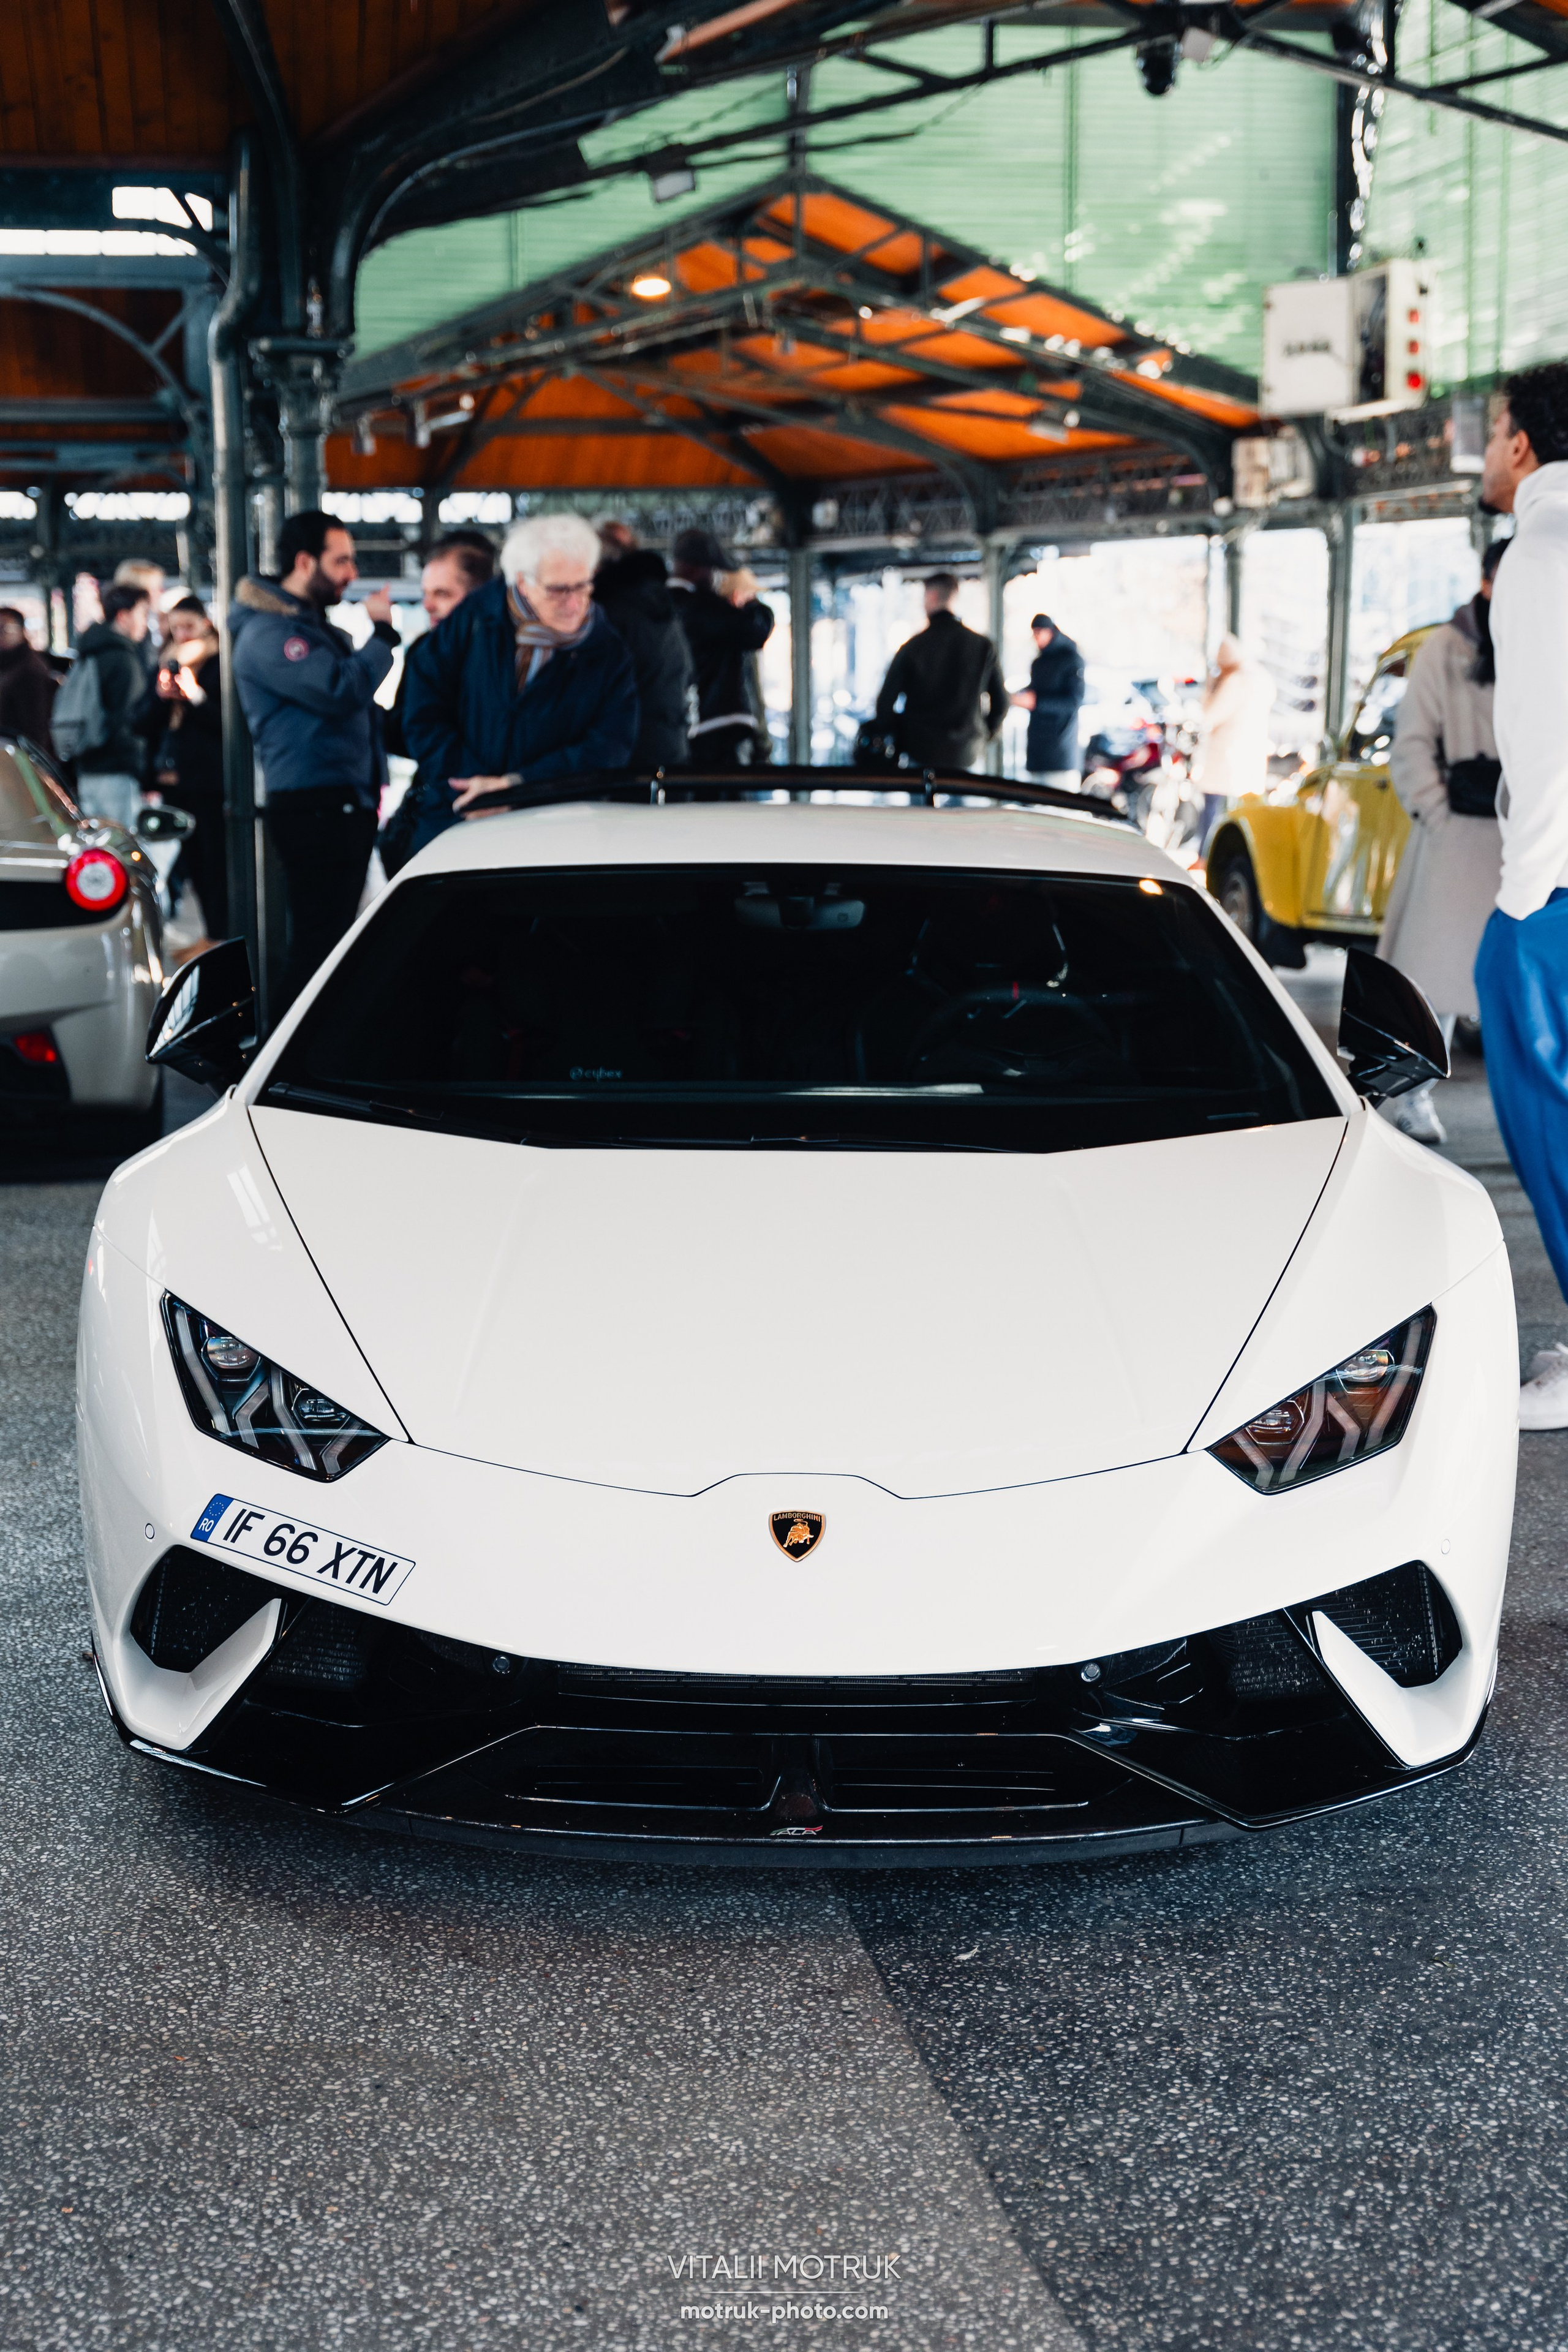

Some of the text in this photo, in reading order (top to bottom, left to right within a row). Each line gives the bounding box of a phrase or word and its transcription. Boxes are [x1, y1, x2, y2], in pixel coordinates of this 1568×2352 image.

[774, 1513, 821, 1522] LAMBORGHINI
[198, 1518, 214, 1532] RO
[223, 1509, 398, 1594] IF 66 XTN
